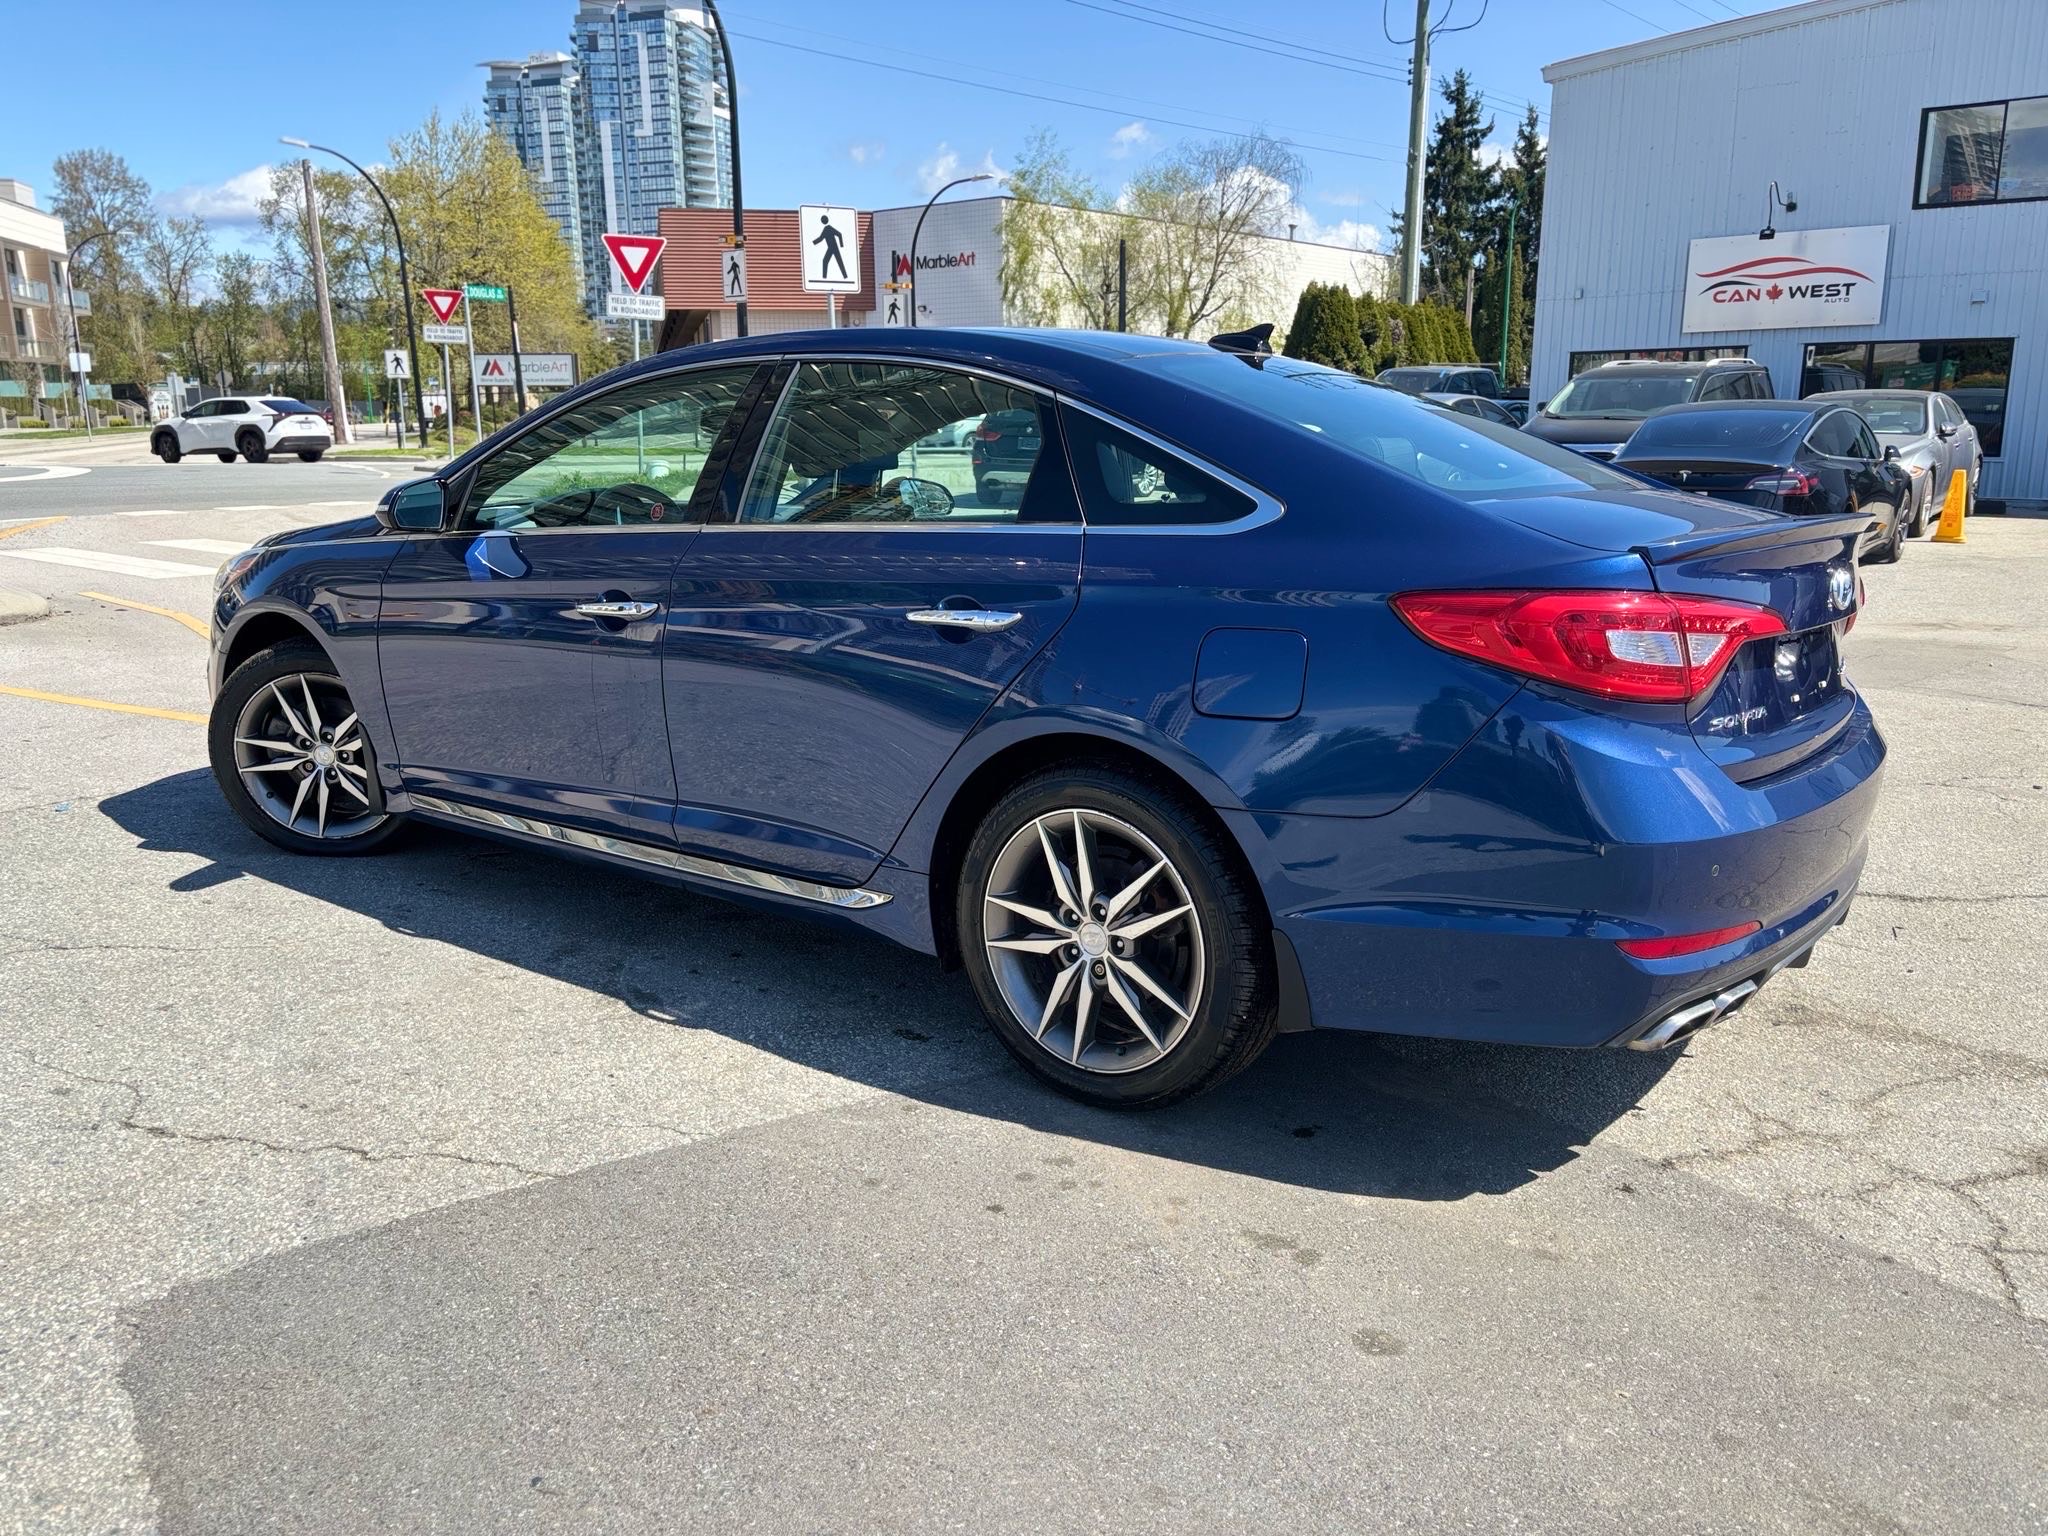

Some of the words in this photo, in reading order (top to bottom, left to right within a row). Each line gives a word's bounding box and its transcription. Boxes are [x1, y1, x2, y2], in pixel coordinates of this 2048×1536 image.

[916, 251, 975, 270] MarbleArt
[470, 287, 496, 298] DOUGLAS
[1713, 288, 1761, 303] CAN
[1788, 282, 1857, 299] WEST
[639, 299, 661, 307] TRAFFIC
[621, 307, 661, 316] ROUNDABOUT
[1707, 706, 1768, 732] SONATA
